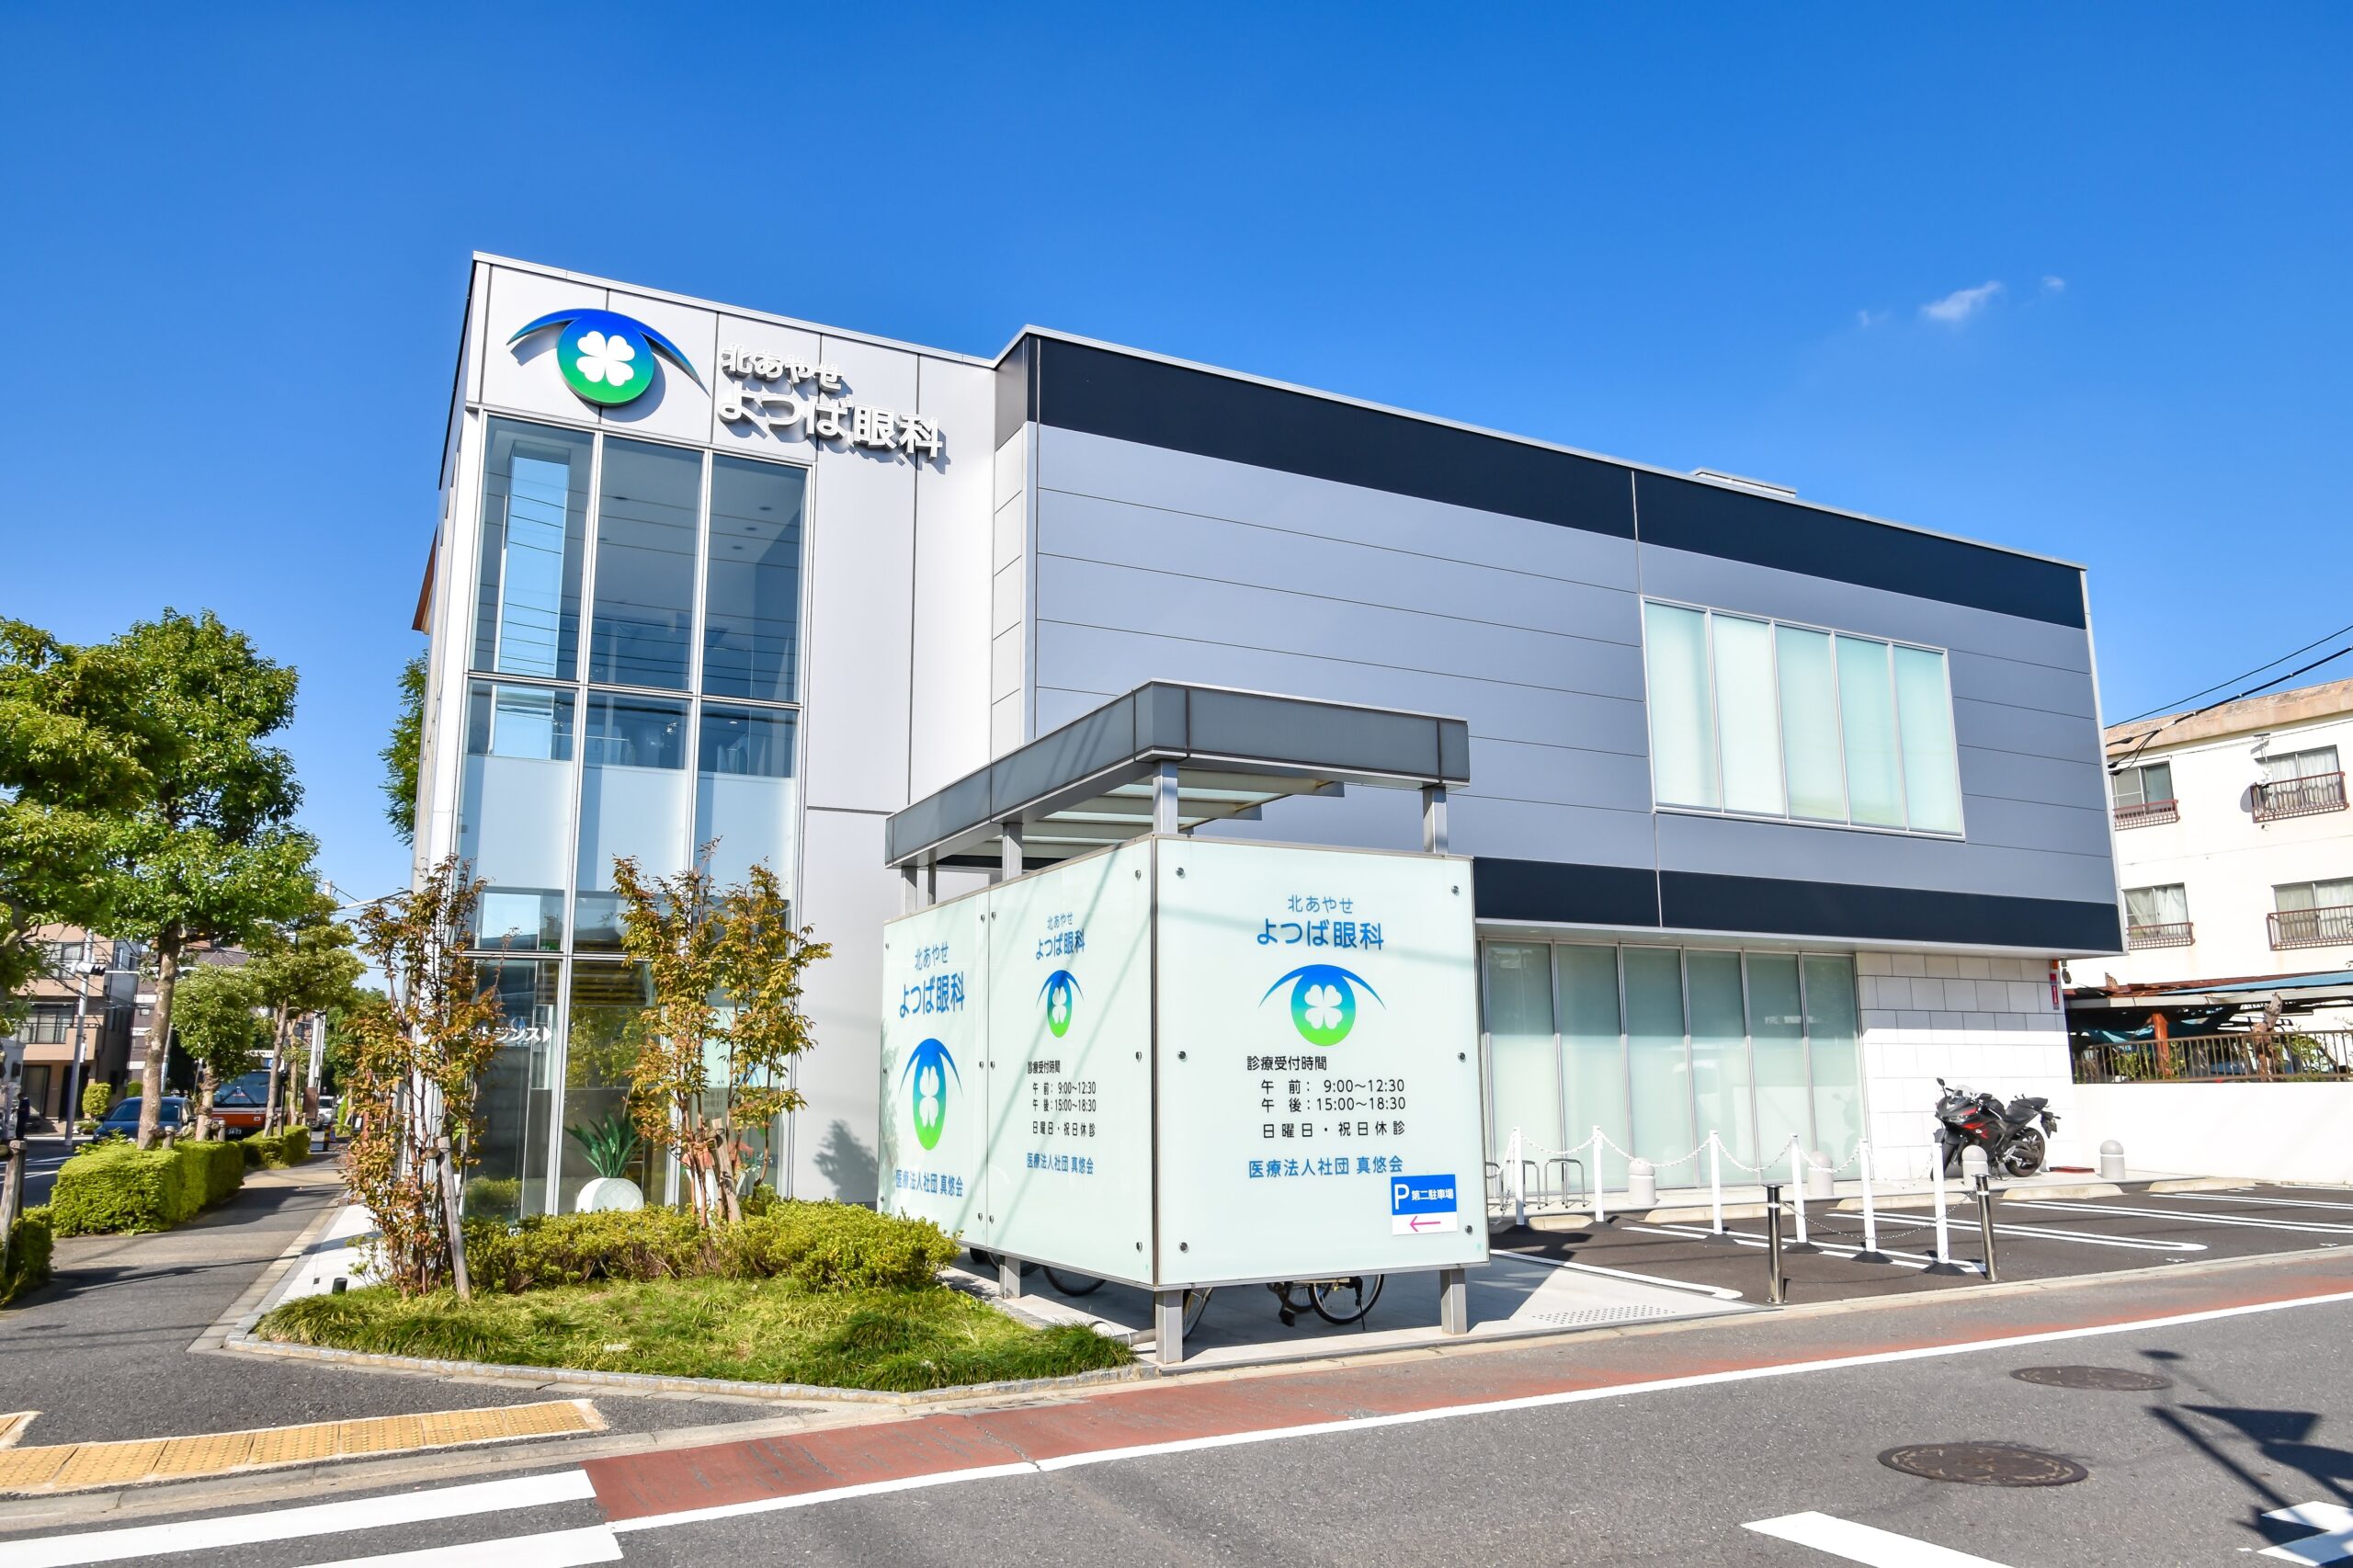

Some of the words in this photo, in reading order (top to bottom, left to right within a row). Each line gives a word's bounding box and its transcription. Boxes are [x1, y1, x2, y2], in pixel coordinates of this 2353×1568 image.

[722, 343, 844, 392] 北あやせ
[717, 381, 943, 459] よつば眼科
[1289, 894, 1353, 915] 北あやせ
[1047, 912, 1074, 930] 北あやせ
[1256, 918, 1384, 950] よつば眼科
[915, 942, 949, 971] 北あやせ
[1035, 928, 1086, 960] よつば眼科
[899, 971, 966, 1018] よつば眼科
[1027, 1060, 1061, 1074] 診療受付時間
[1246, 1055, 1327, 1071] 診療受付時間
[1394, 1183, 1410, 1210] P
[1411, 1188, 1454, 1201] 第二駐車場
